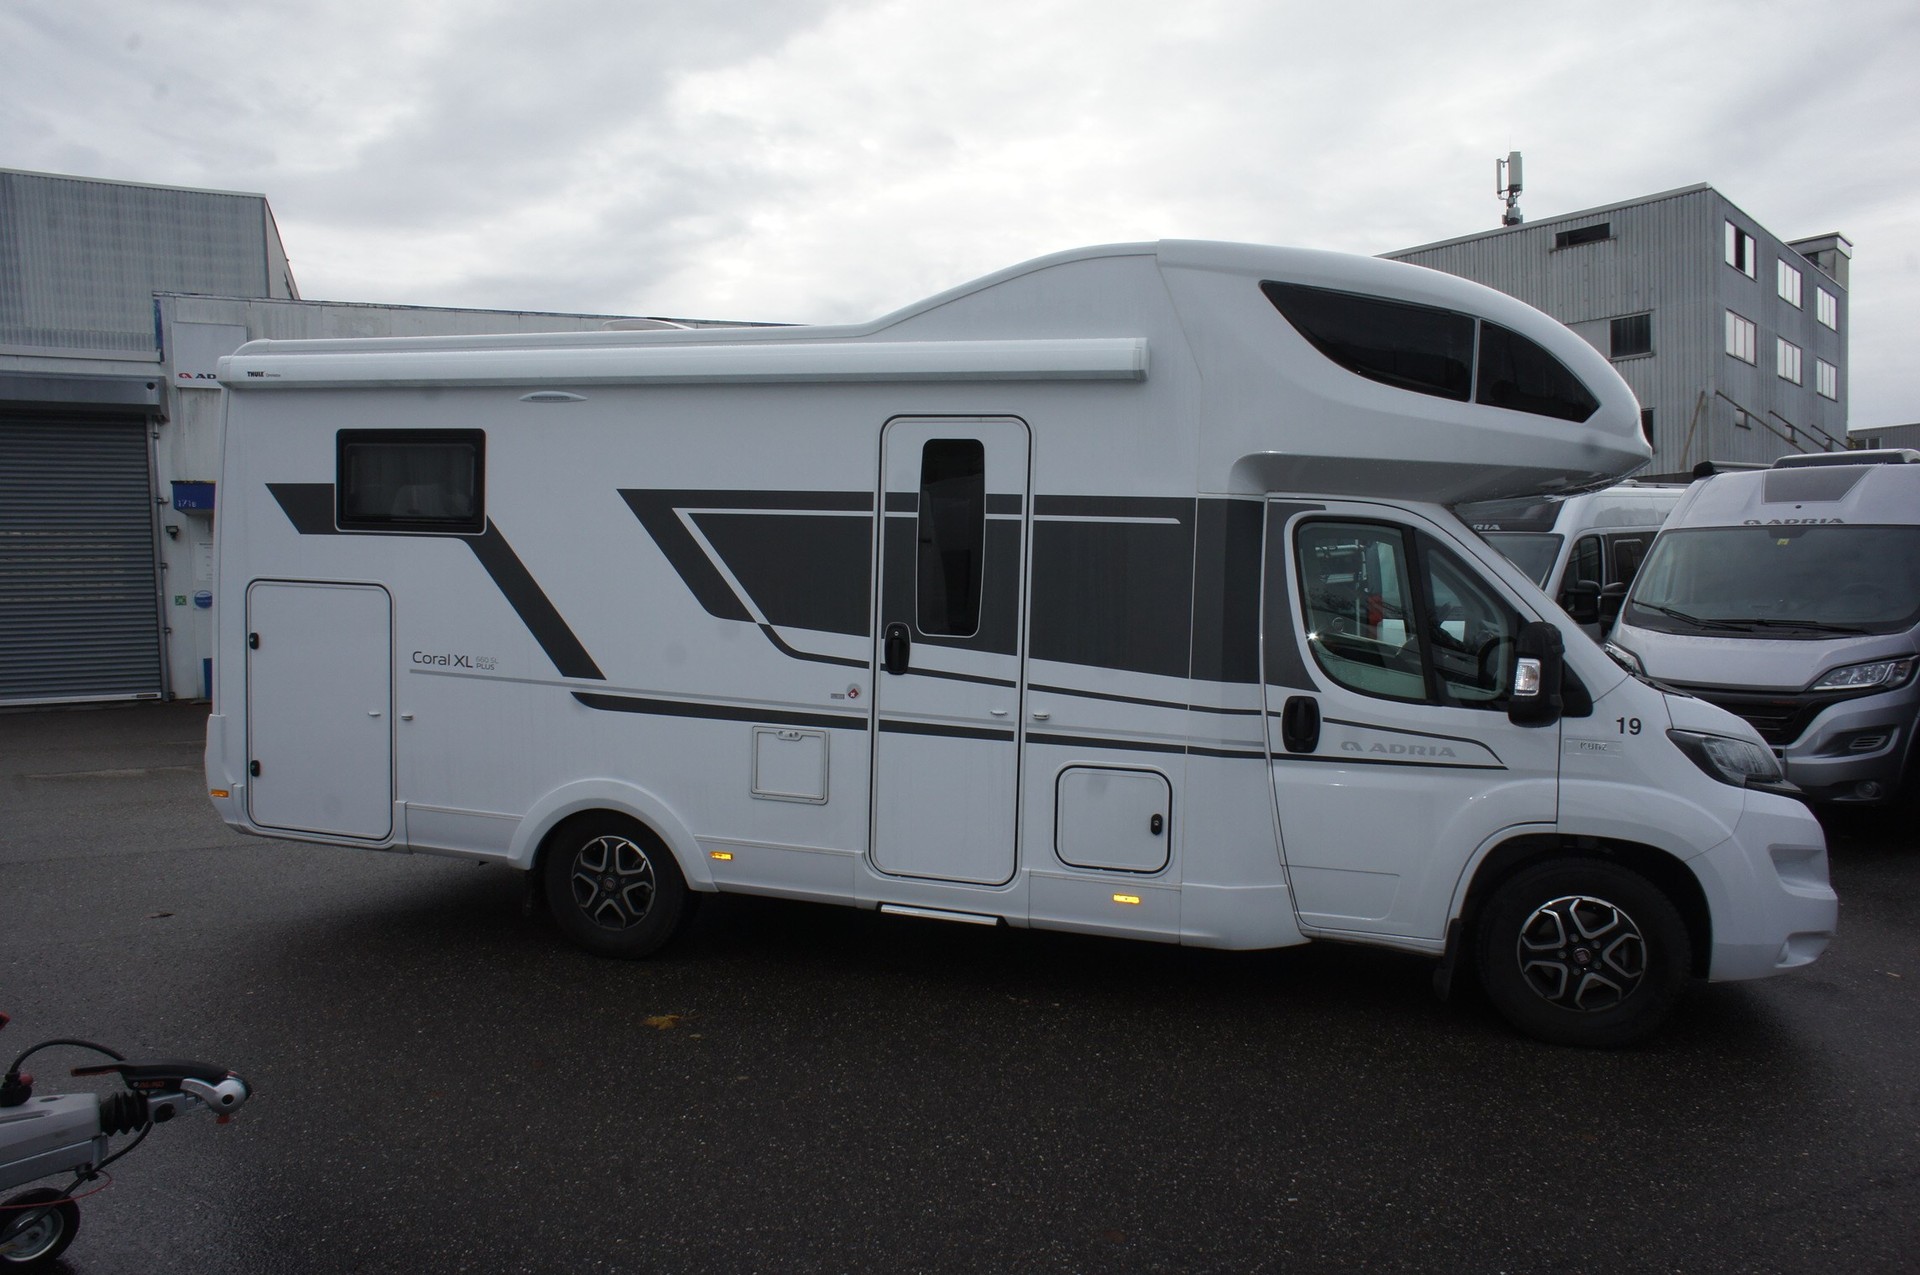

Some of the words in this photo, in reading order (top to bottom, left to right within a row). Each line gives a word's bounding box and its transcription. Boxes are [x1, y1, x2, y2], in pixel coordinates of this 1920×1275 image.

[412, 651, 451, 666] Coral
[453, 654, 474, 669] XL
[476, 662, 495, 671] PLUS
[1615, 717, 1642, 736] 19
[1369, 742, 1456, 758] ADRIA
